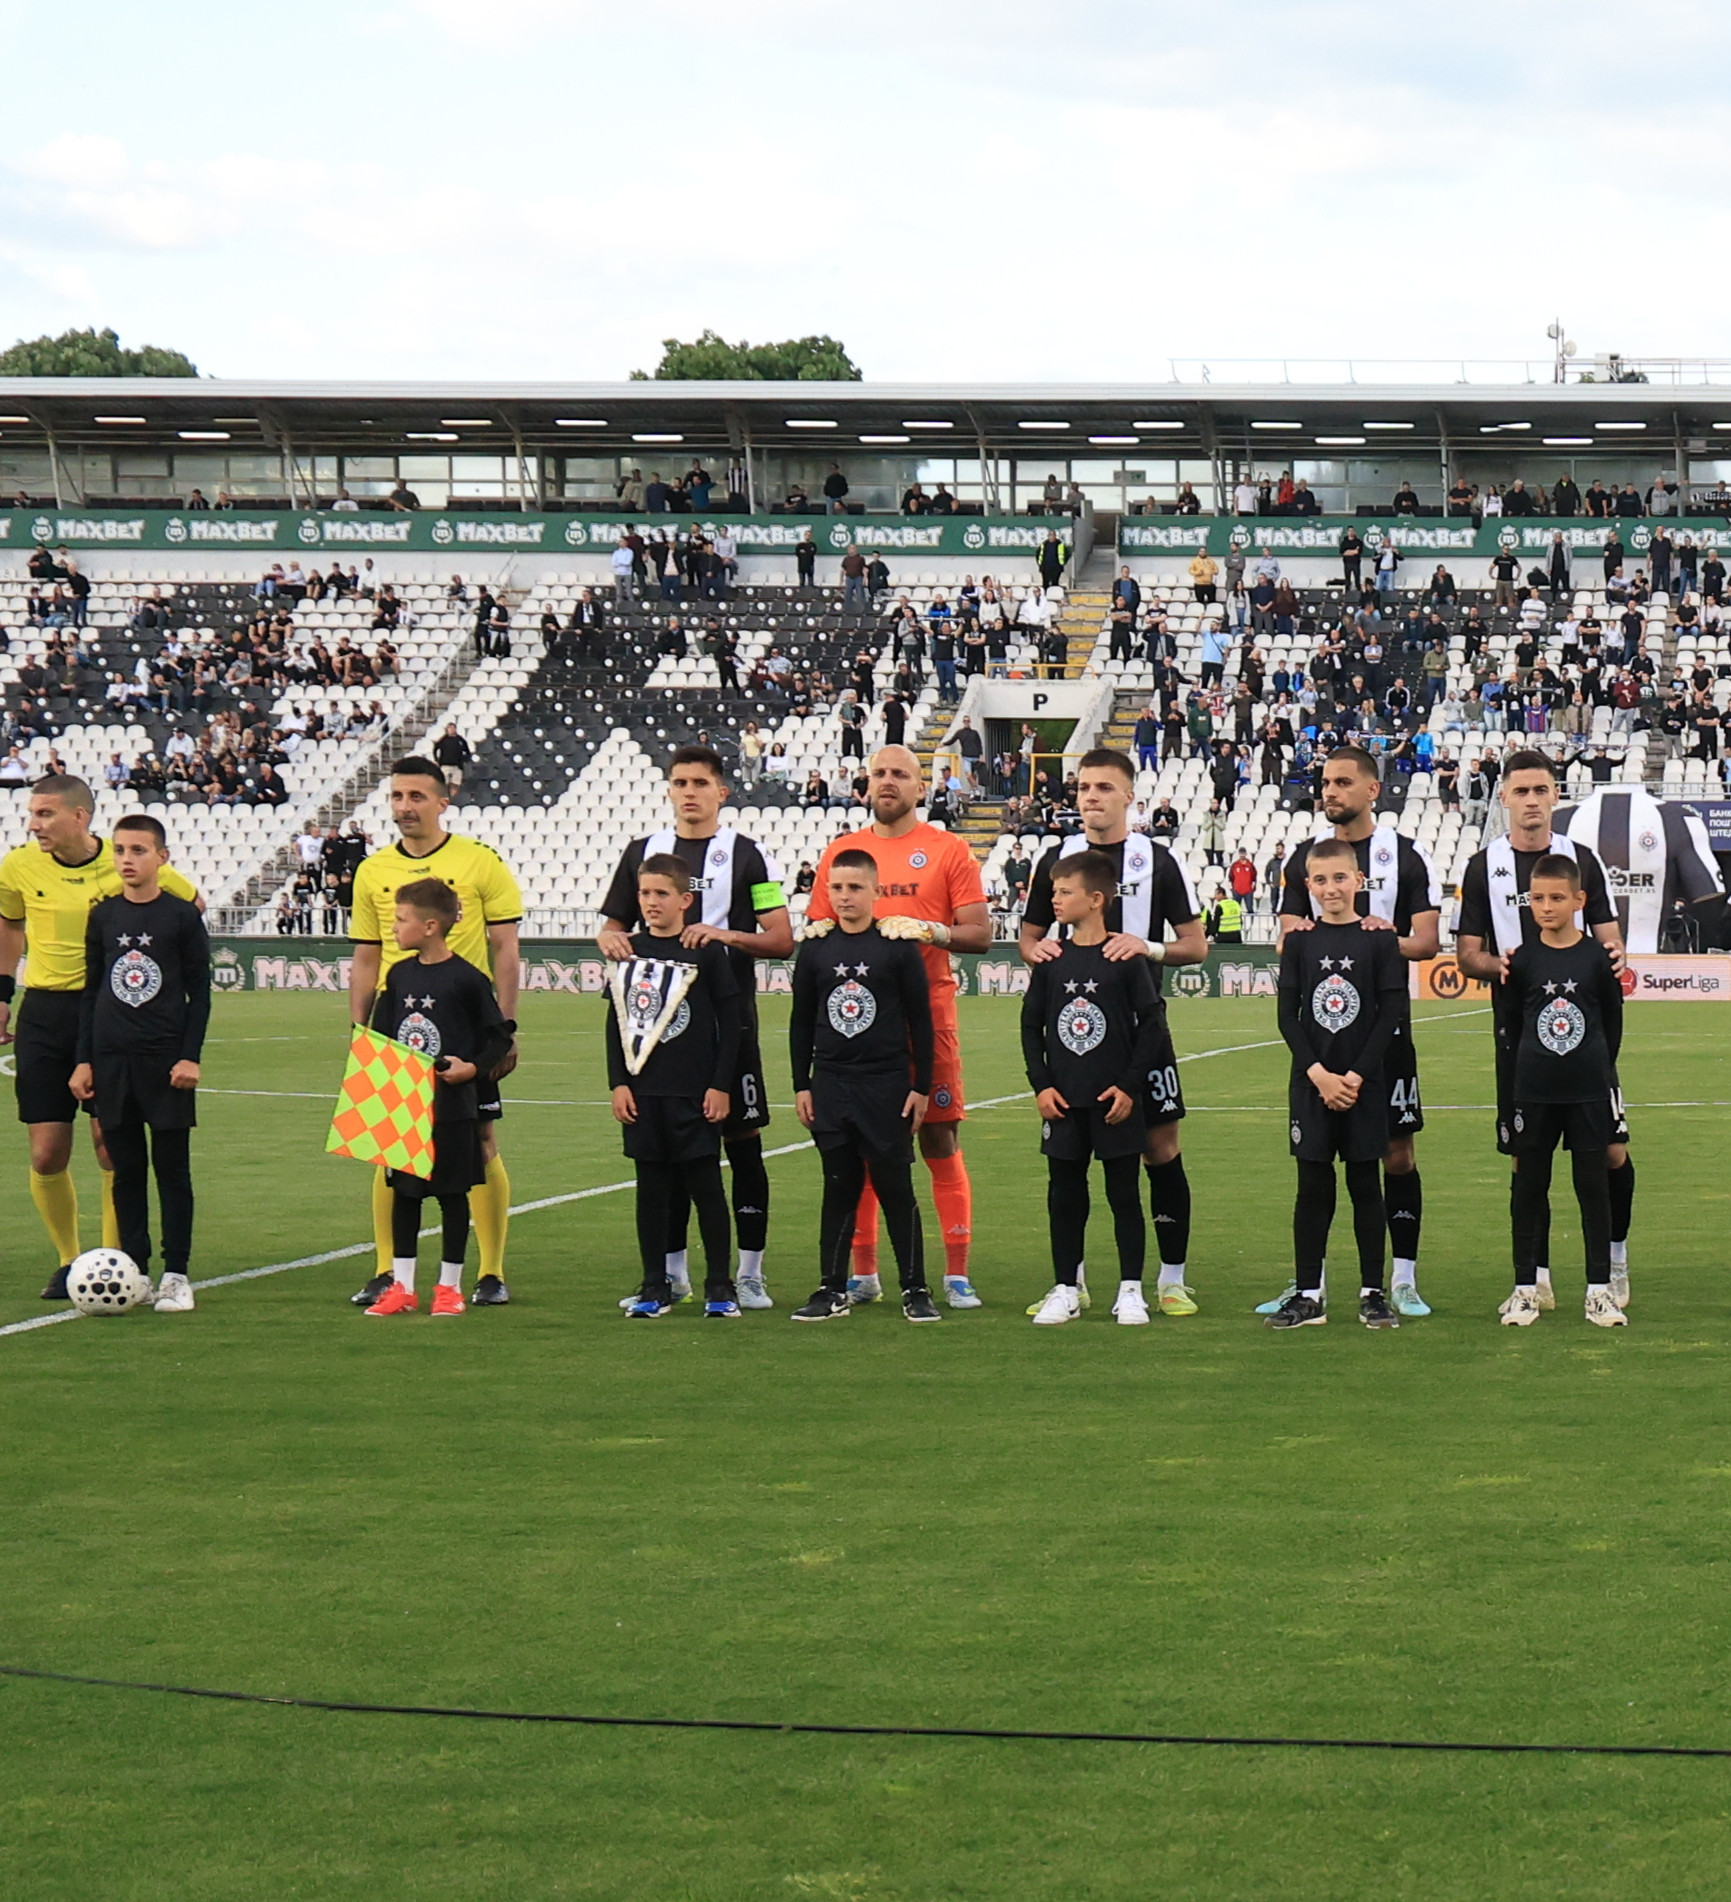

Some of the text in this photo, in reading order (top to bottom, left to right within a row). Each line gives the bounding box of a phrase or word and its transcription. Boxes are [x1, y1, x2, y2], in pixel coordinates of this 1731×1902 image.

[56, 520, 145, 541] MAXBET
[189, 520, 279, 542] MAXBET
[322, 521, 412, 542] MAXBET
[456, 522, 546, 544] MAXBET
[855, 526, 943, 547] MAXBET
[1122, 527, 1210, 548] MAXBET
[1254, 527, 1343, 549] MAXBET
[1388, 527, 1477, 549] MAXBET
[1033, 693, 1049, 711] P
[1439, 970, 1459, 990] M
[1643, 974, 1720, 993] SuperLiga
[741, 1073, 758, 1106] 6
[1148, 1065, 1179, 1101] 30
[1390, 1076, 1419, 1111] 44
